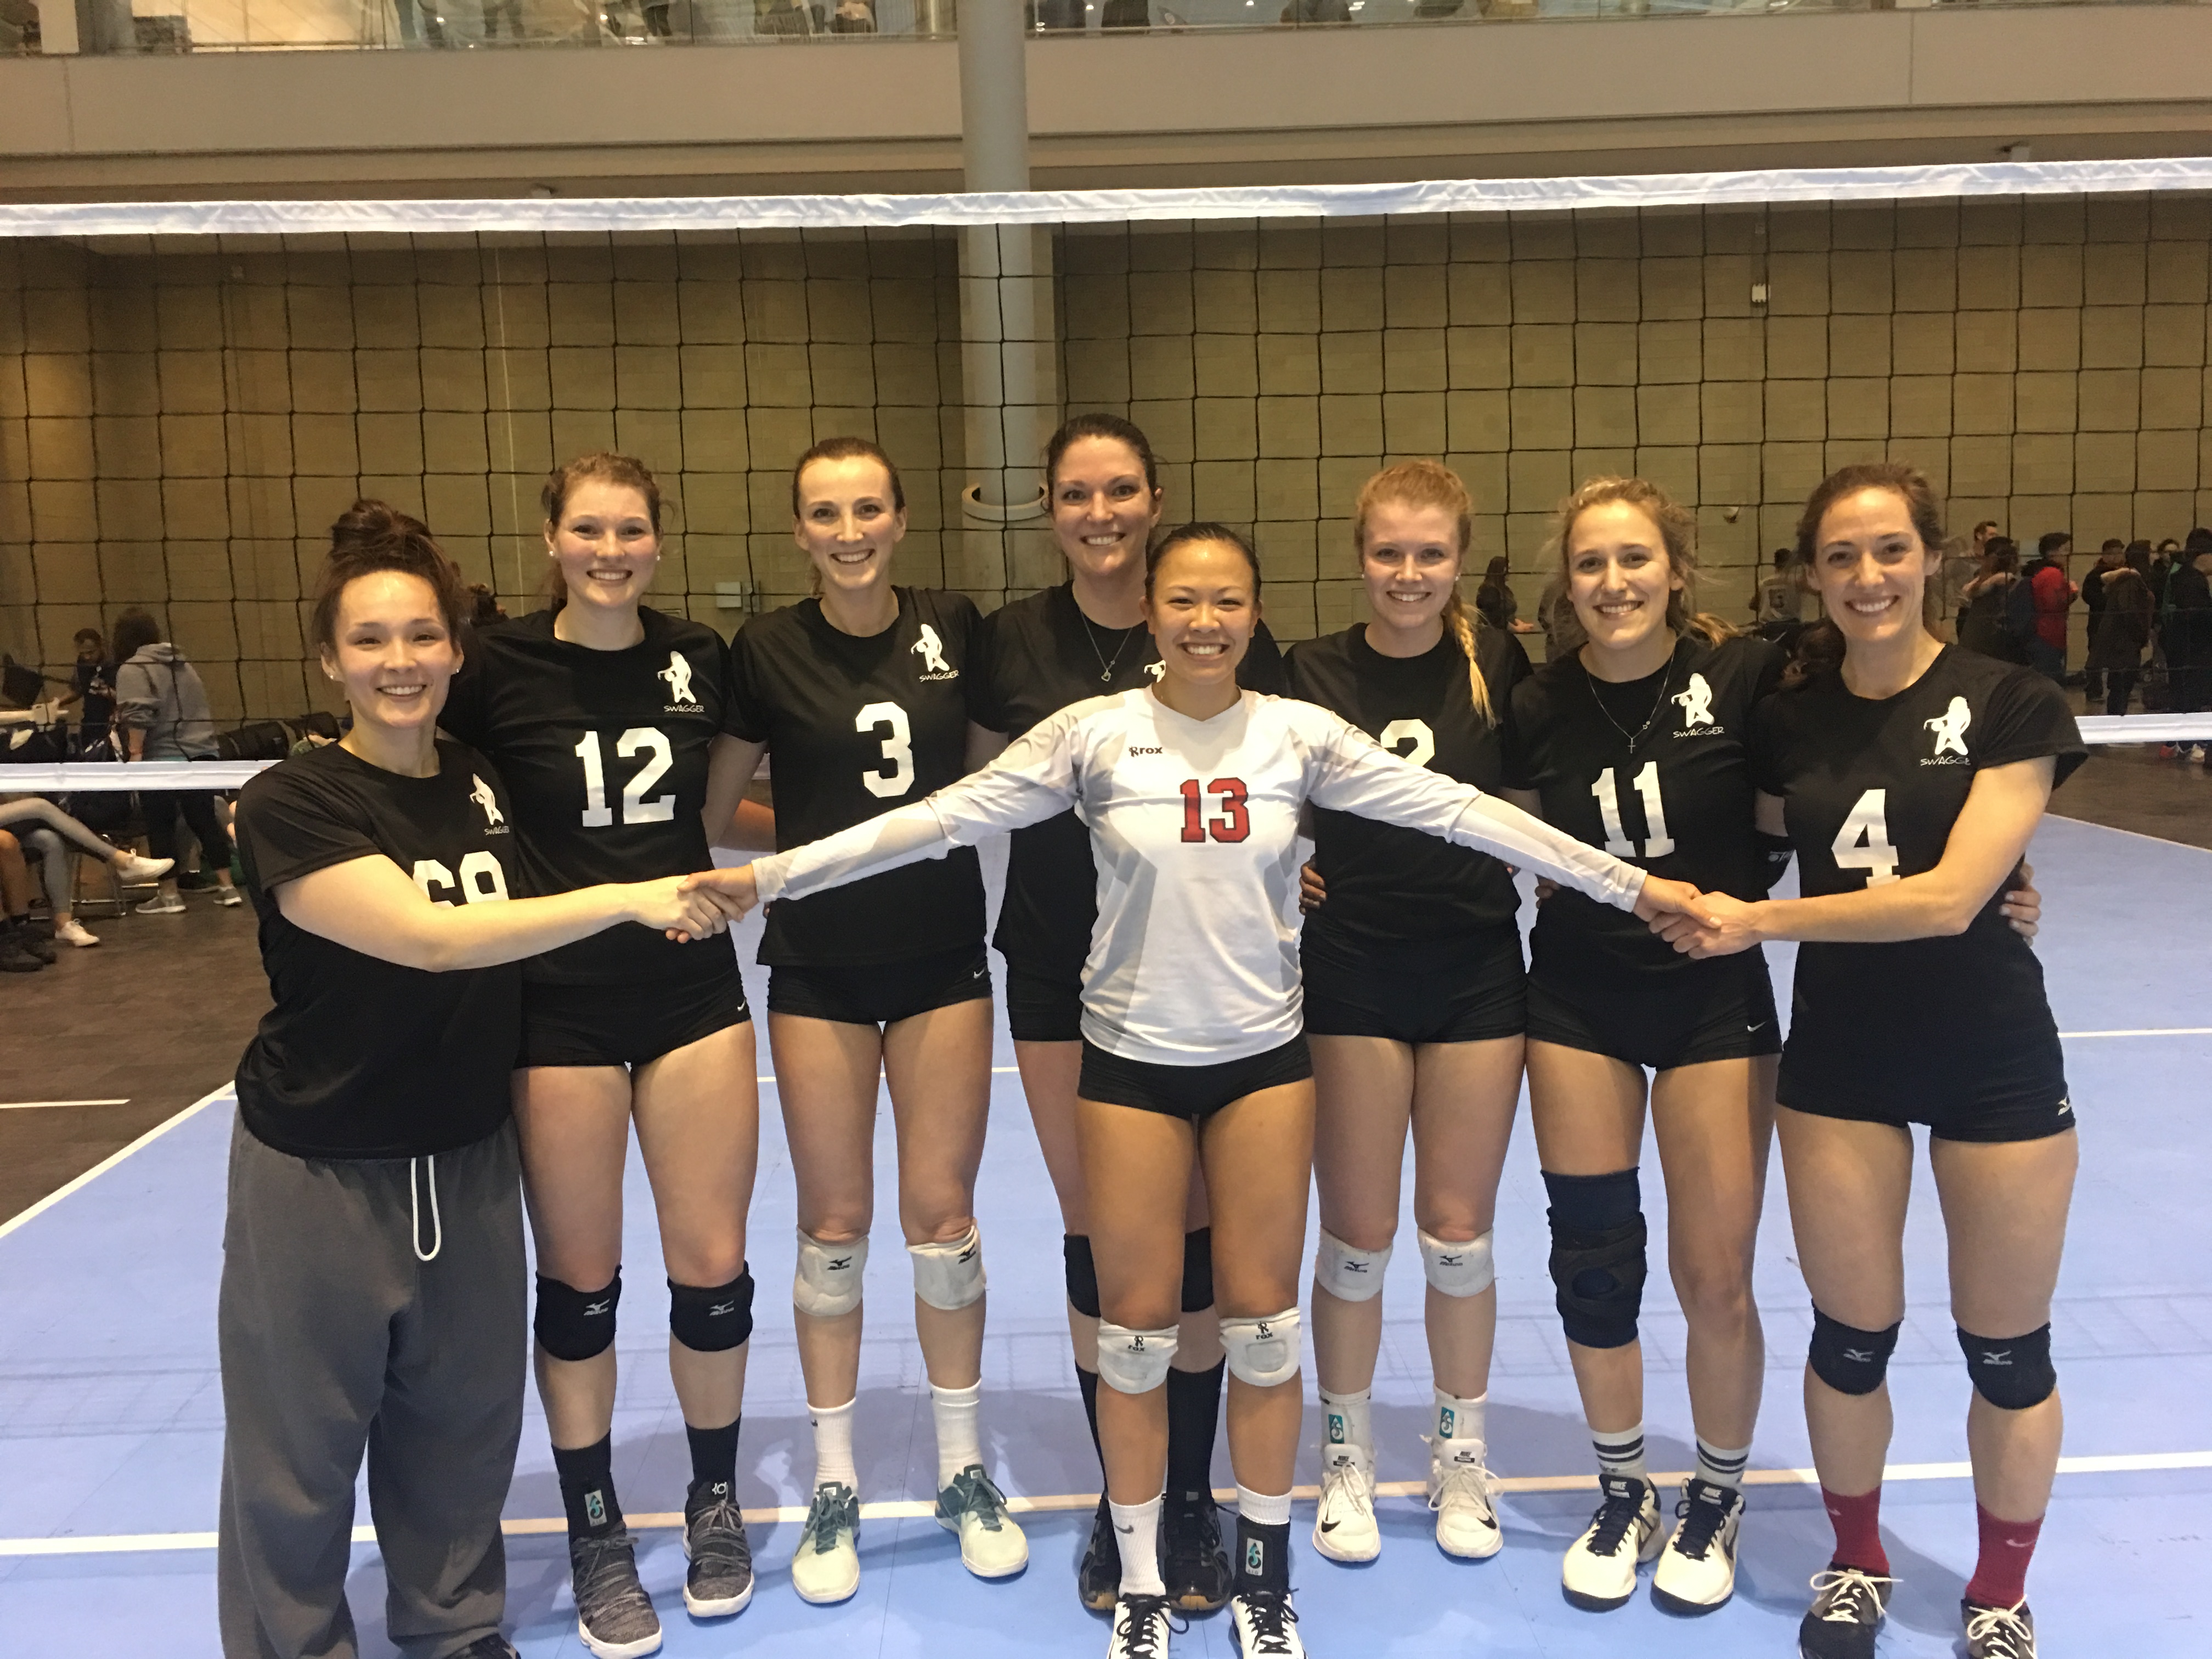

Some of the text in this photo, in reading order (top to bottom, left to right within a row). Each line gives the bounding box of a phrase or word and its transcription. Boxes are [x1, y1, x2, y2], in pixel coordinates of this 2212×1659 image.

[663, 704, 705, 713] SWAGGER
[919, 670, 960, 682] SWAGGER
[855, 701, 915, 798] 3
[1673, 726, 1725, 738] SWAGGER
[1920, 755, 1971, 766] SWAGGE
[575, 727, 676, 827] 12
[1180, 777, 1250, 843] 13
[1592, 761, 1674, 857] 11
[1831, 788, 1900, 889] 4
